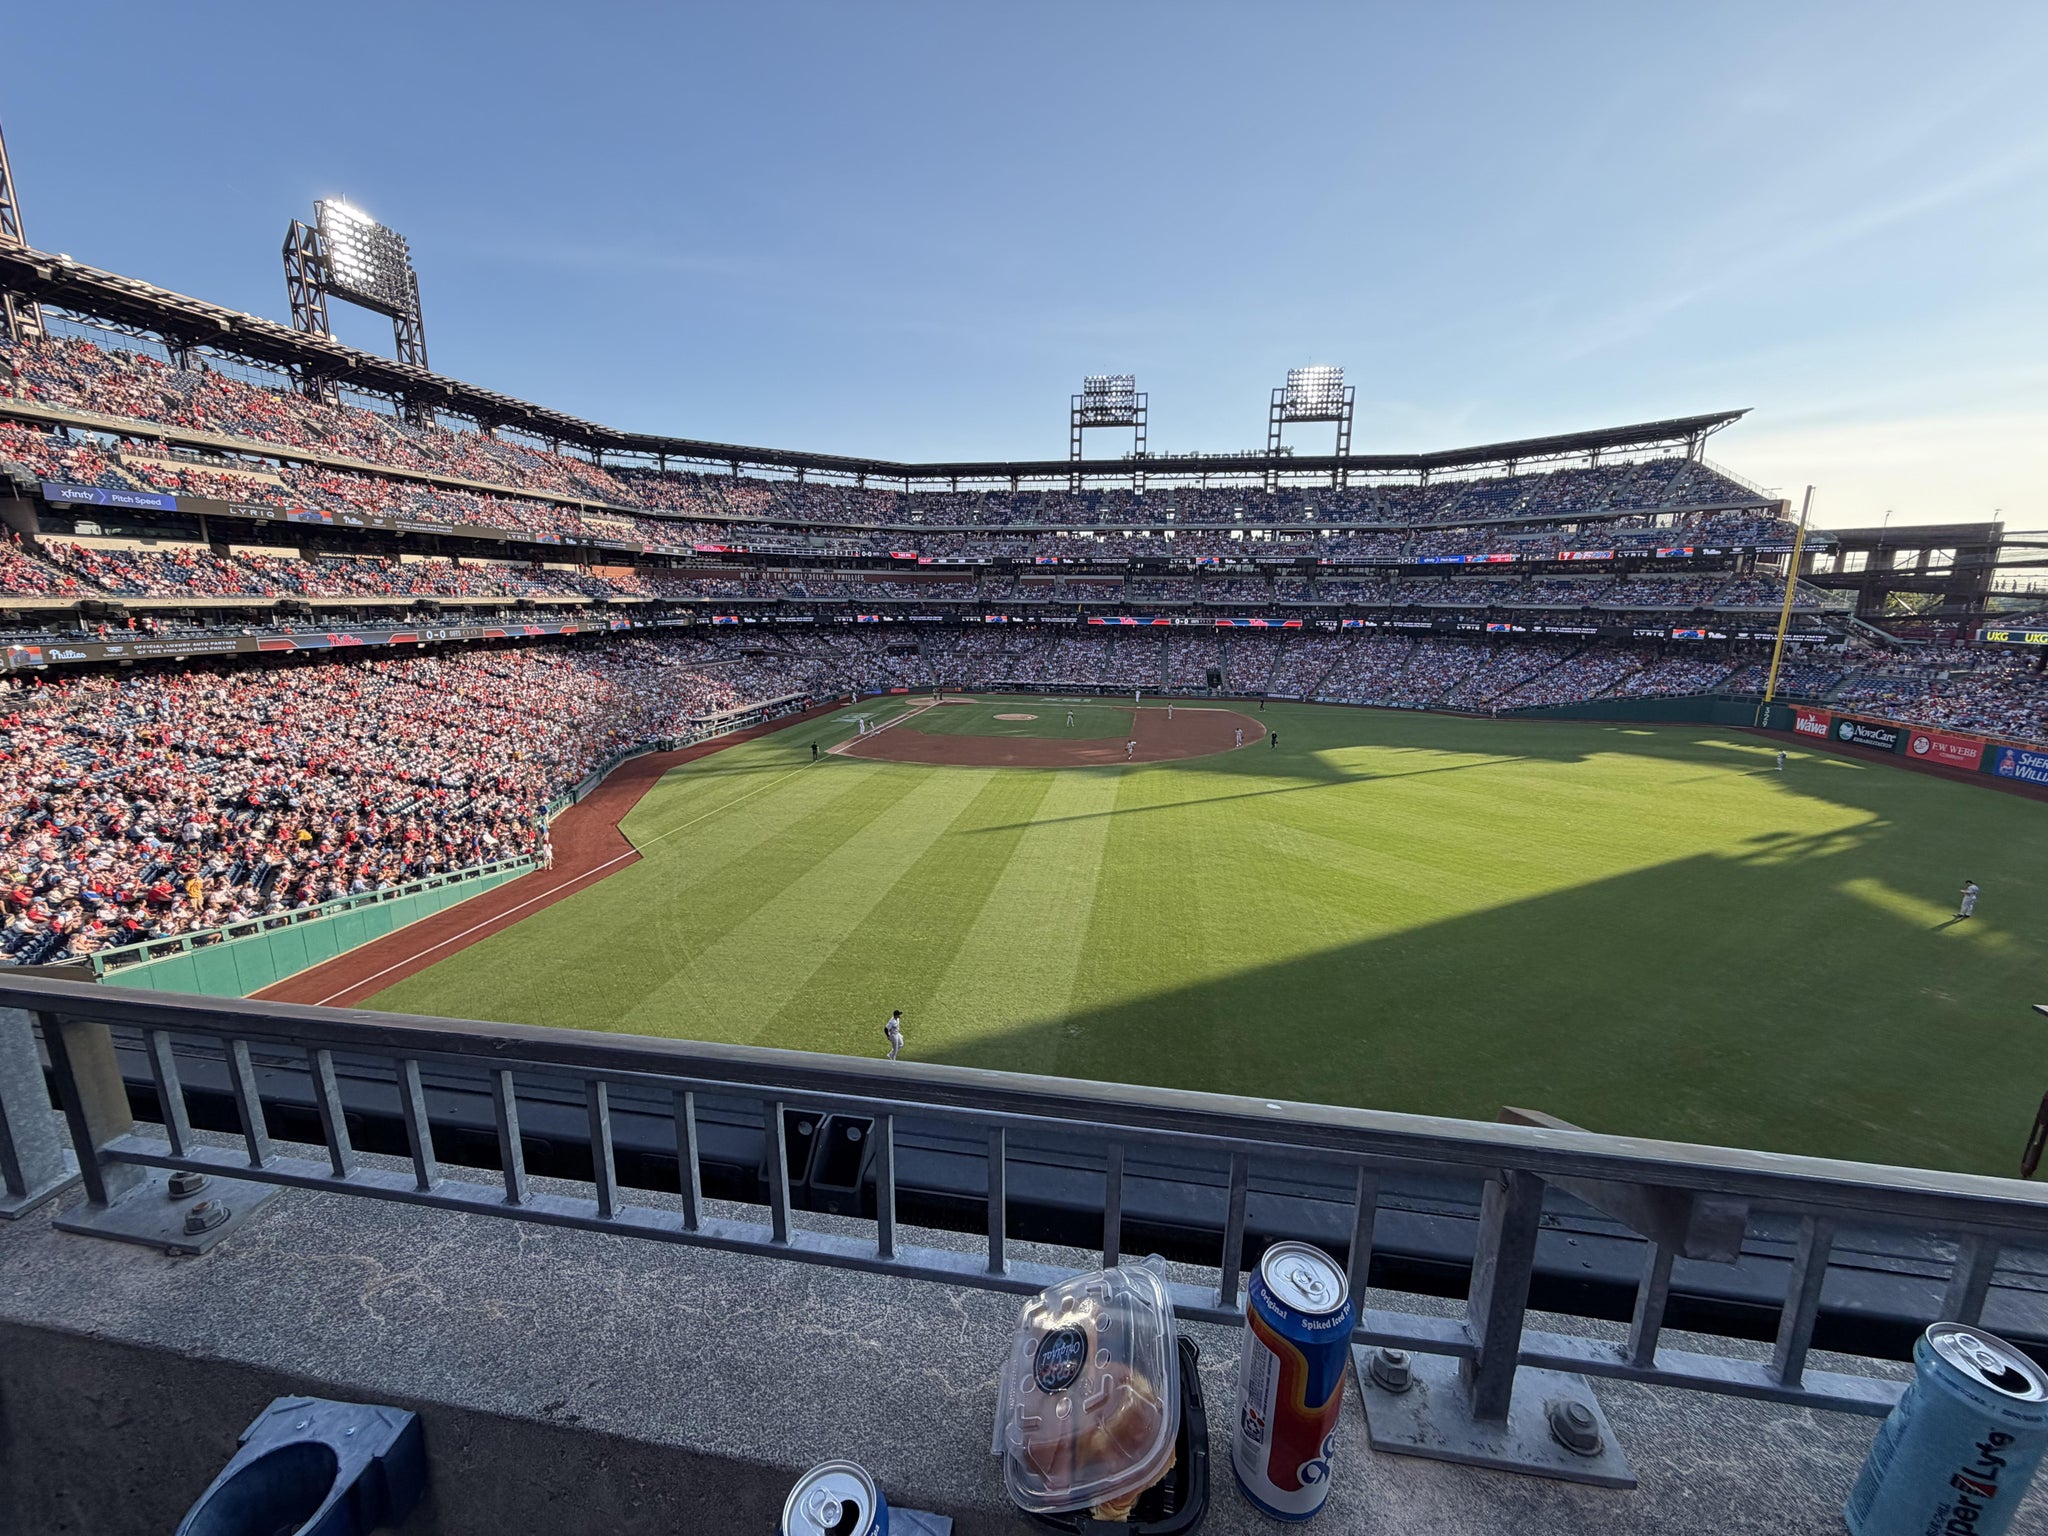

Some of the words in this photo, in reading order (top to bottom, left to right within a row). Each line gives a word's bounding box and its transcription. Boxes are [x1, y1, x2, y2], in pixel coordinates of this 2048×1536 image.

[61, 489, 94, 501] xfinity
[111, 494, 134, 503] Pitch
[135, 496, 162, 506] Speed
[229, 507, 275, 518] LYRIQ
[762, 572, 770, 580] OF
[774, 572, 786, 580] THE
[426, 630, 446, 640] 0-0
[1987, 631, 2009, 641] UKG
[2025, 632, 2048, 643] UKG
[49, 648, 87, 660] Phillies
[1762, 706, 1770, 728] 329
[1796, 717, 1828, 735] Wawa
[1854, 725, 1896, 742] NovaCare
[1949, 745, 1977, 758] WEBB
[1261, 1288, 1288, 1320] Original
[1302, 1318, 1332, 1331] Spiked
[1332, 1312, 1345, 1327] Iced
[1943, 1493, 1984, 1536] per
